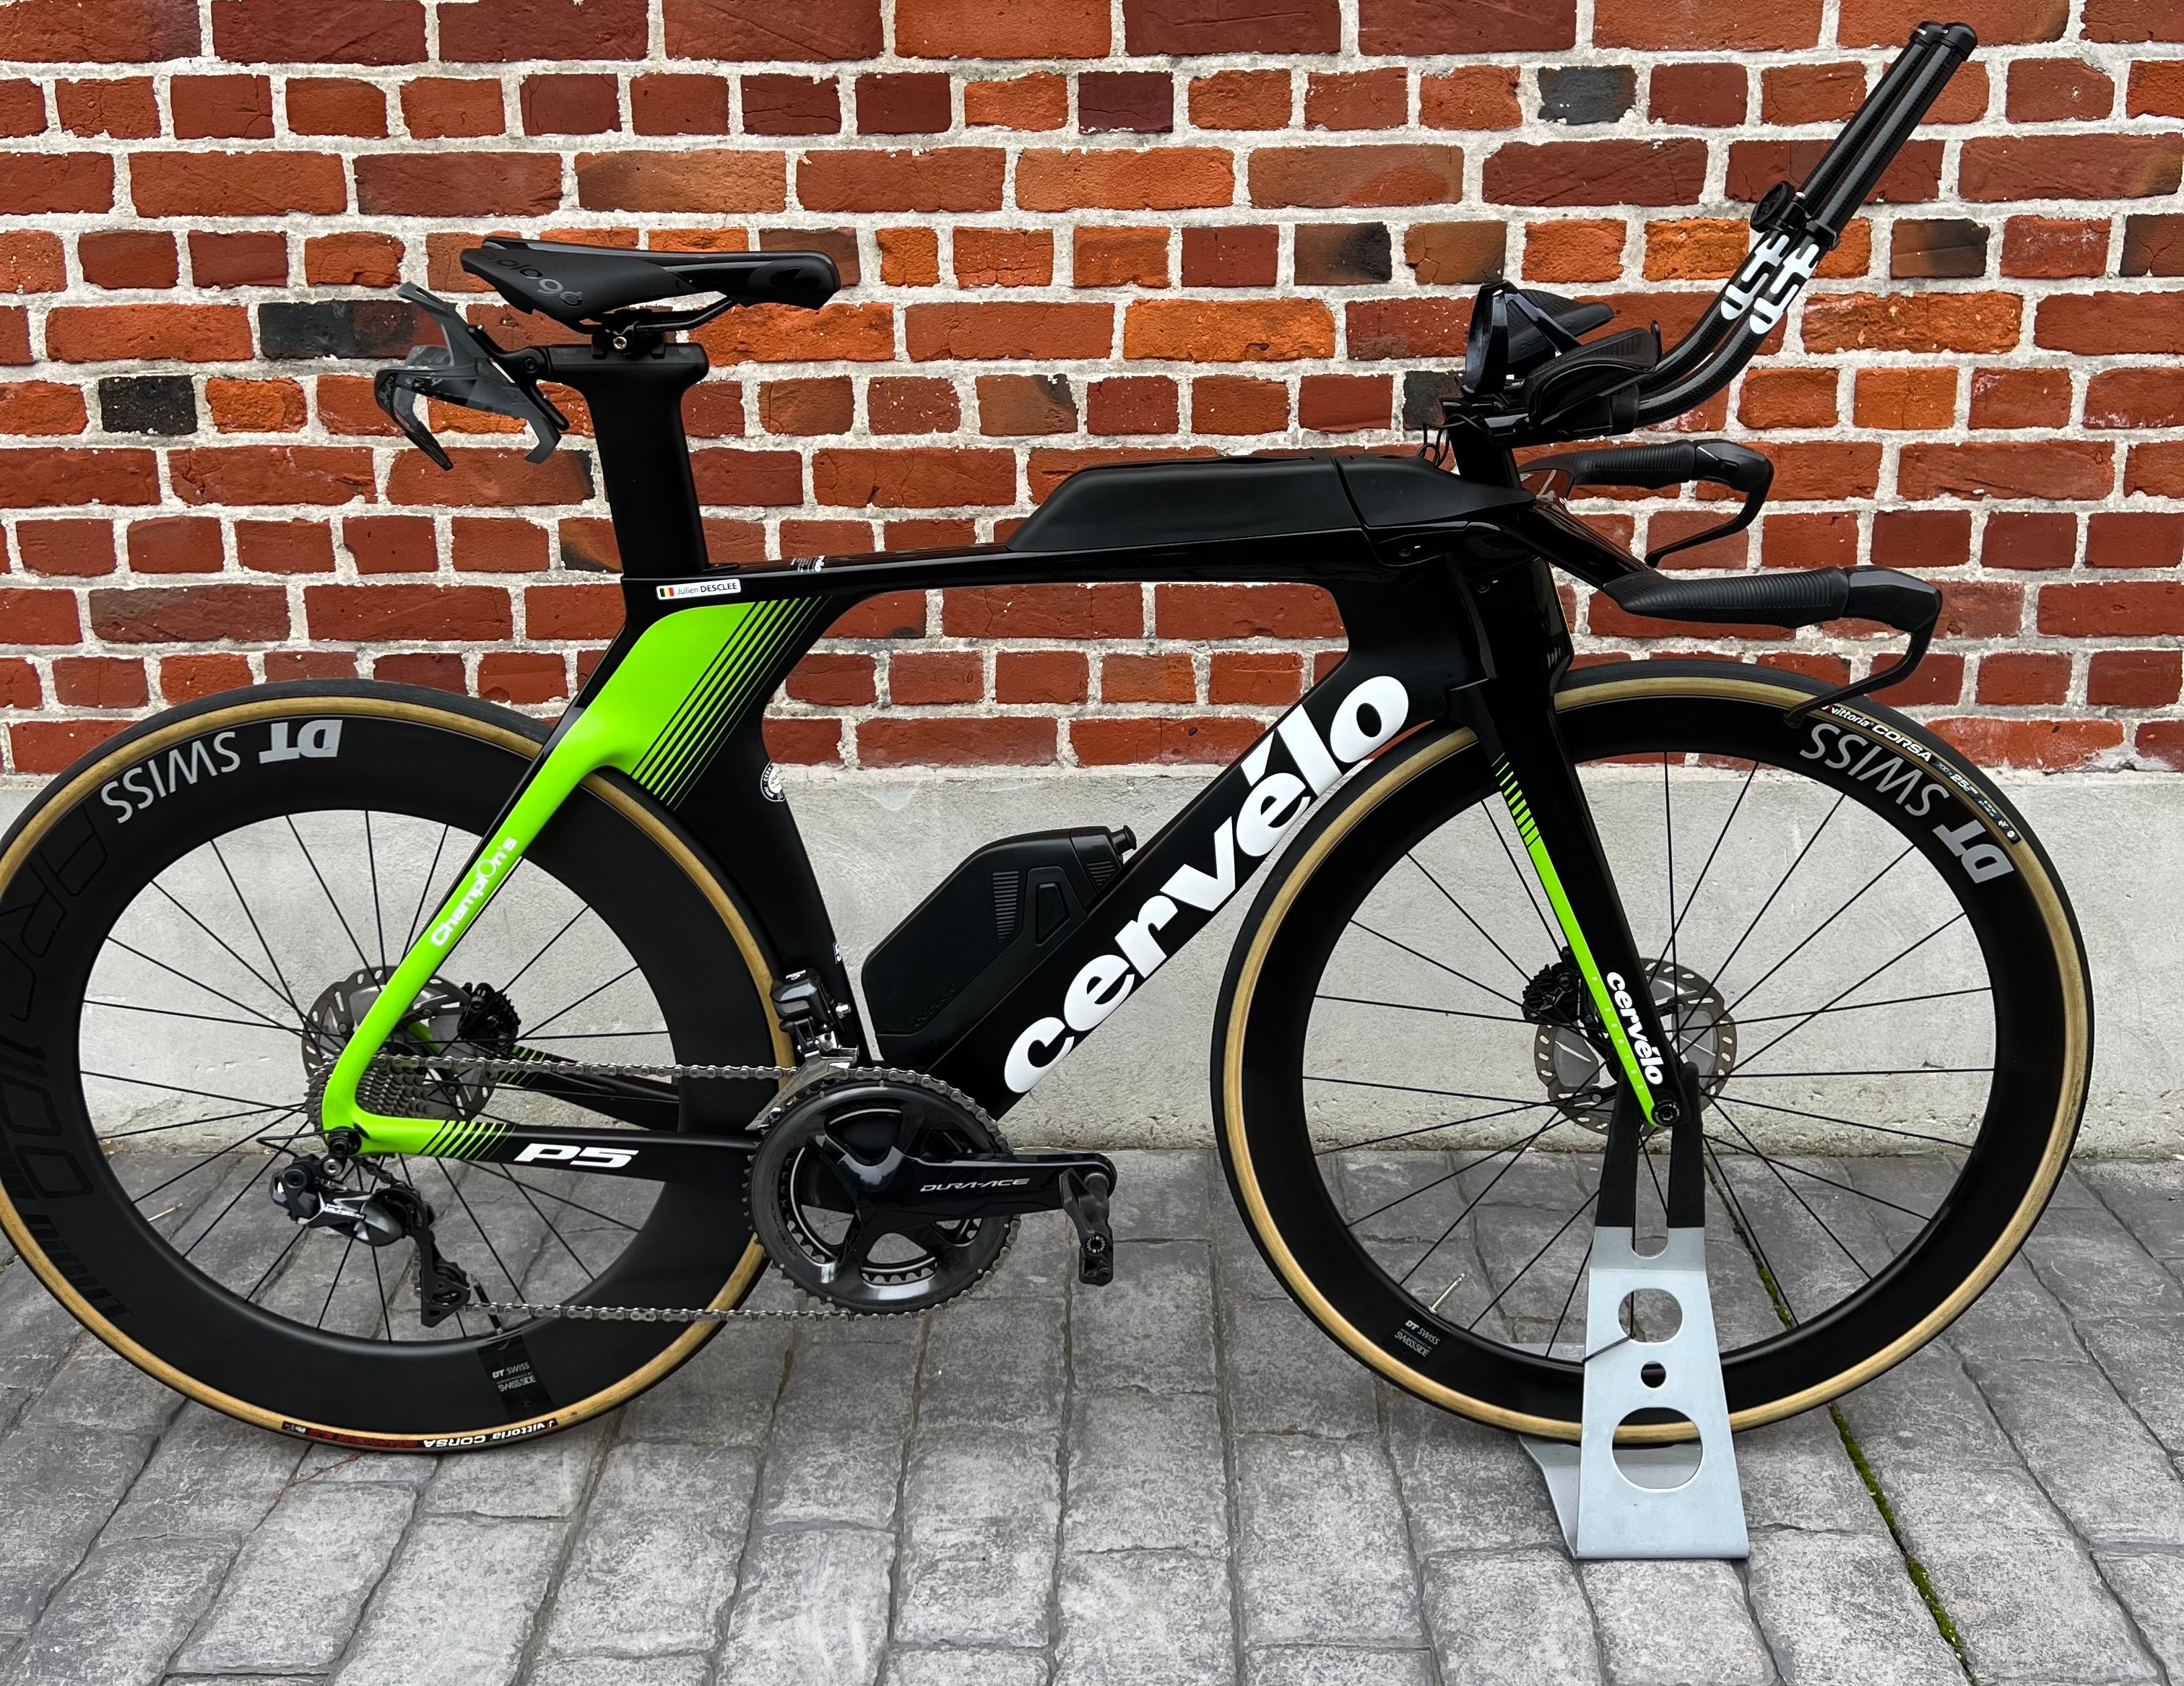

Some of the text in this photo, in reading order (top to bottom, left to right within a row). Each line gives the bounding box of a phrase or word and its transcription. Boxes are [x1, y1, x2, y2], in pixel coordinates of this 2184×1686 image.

[677, 582, 737, 594] Julien DESCLEE
[1831, 707, 1871, 727] vittoria
[1872, 724, 1930, 762] CORSA
[100, 720, 343, 824] DT SWISS
[1799, 723, 2014, 884] DT SWISS
[1004, 676, 1409, 1092] cervélo
[1606, 972, 1664, 1085] cervélo
[514, 1143, 639, 1168] P5
[920, 1178, 1031, 1192] DURA-ACE
[492, 1369, 505, 1379] DT
[506, 1362, 530, 1375] SWISS
[423, 1437, 486, 1448] CORSA
[492, 1422, 546, 1440] vittoria
